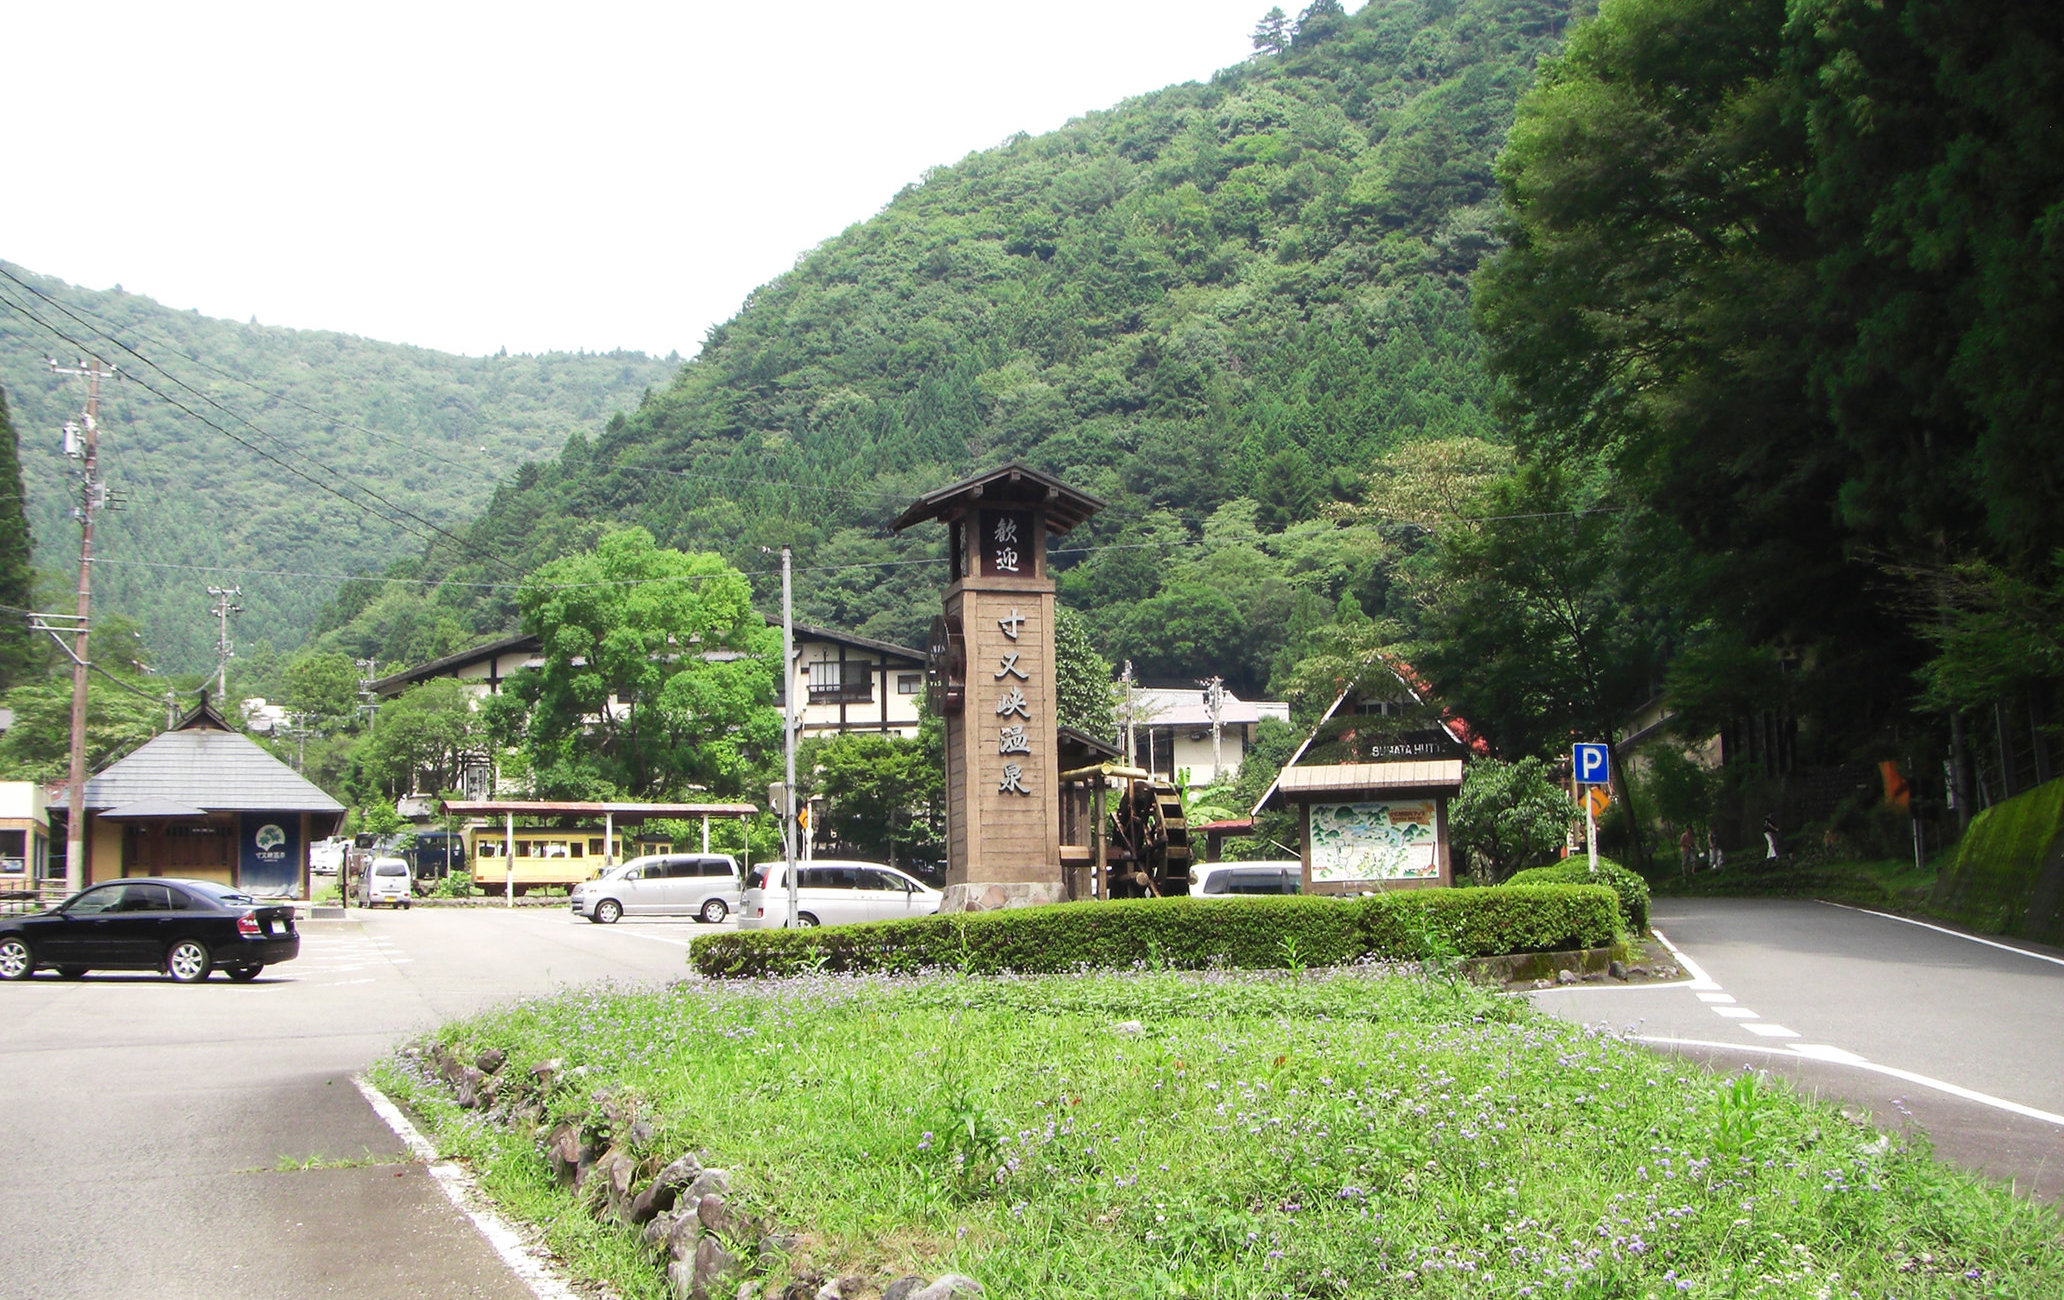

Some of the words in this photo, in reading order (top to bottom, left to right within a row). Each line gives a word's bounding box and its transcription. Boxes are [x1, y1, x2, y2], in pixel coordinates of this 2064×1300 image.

[994, 608, 1031, 796] 寸又峡温泉
[1583, 747, 1602, 779] P
